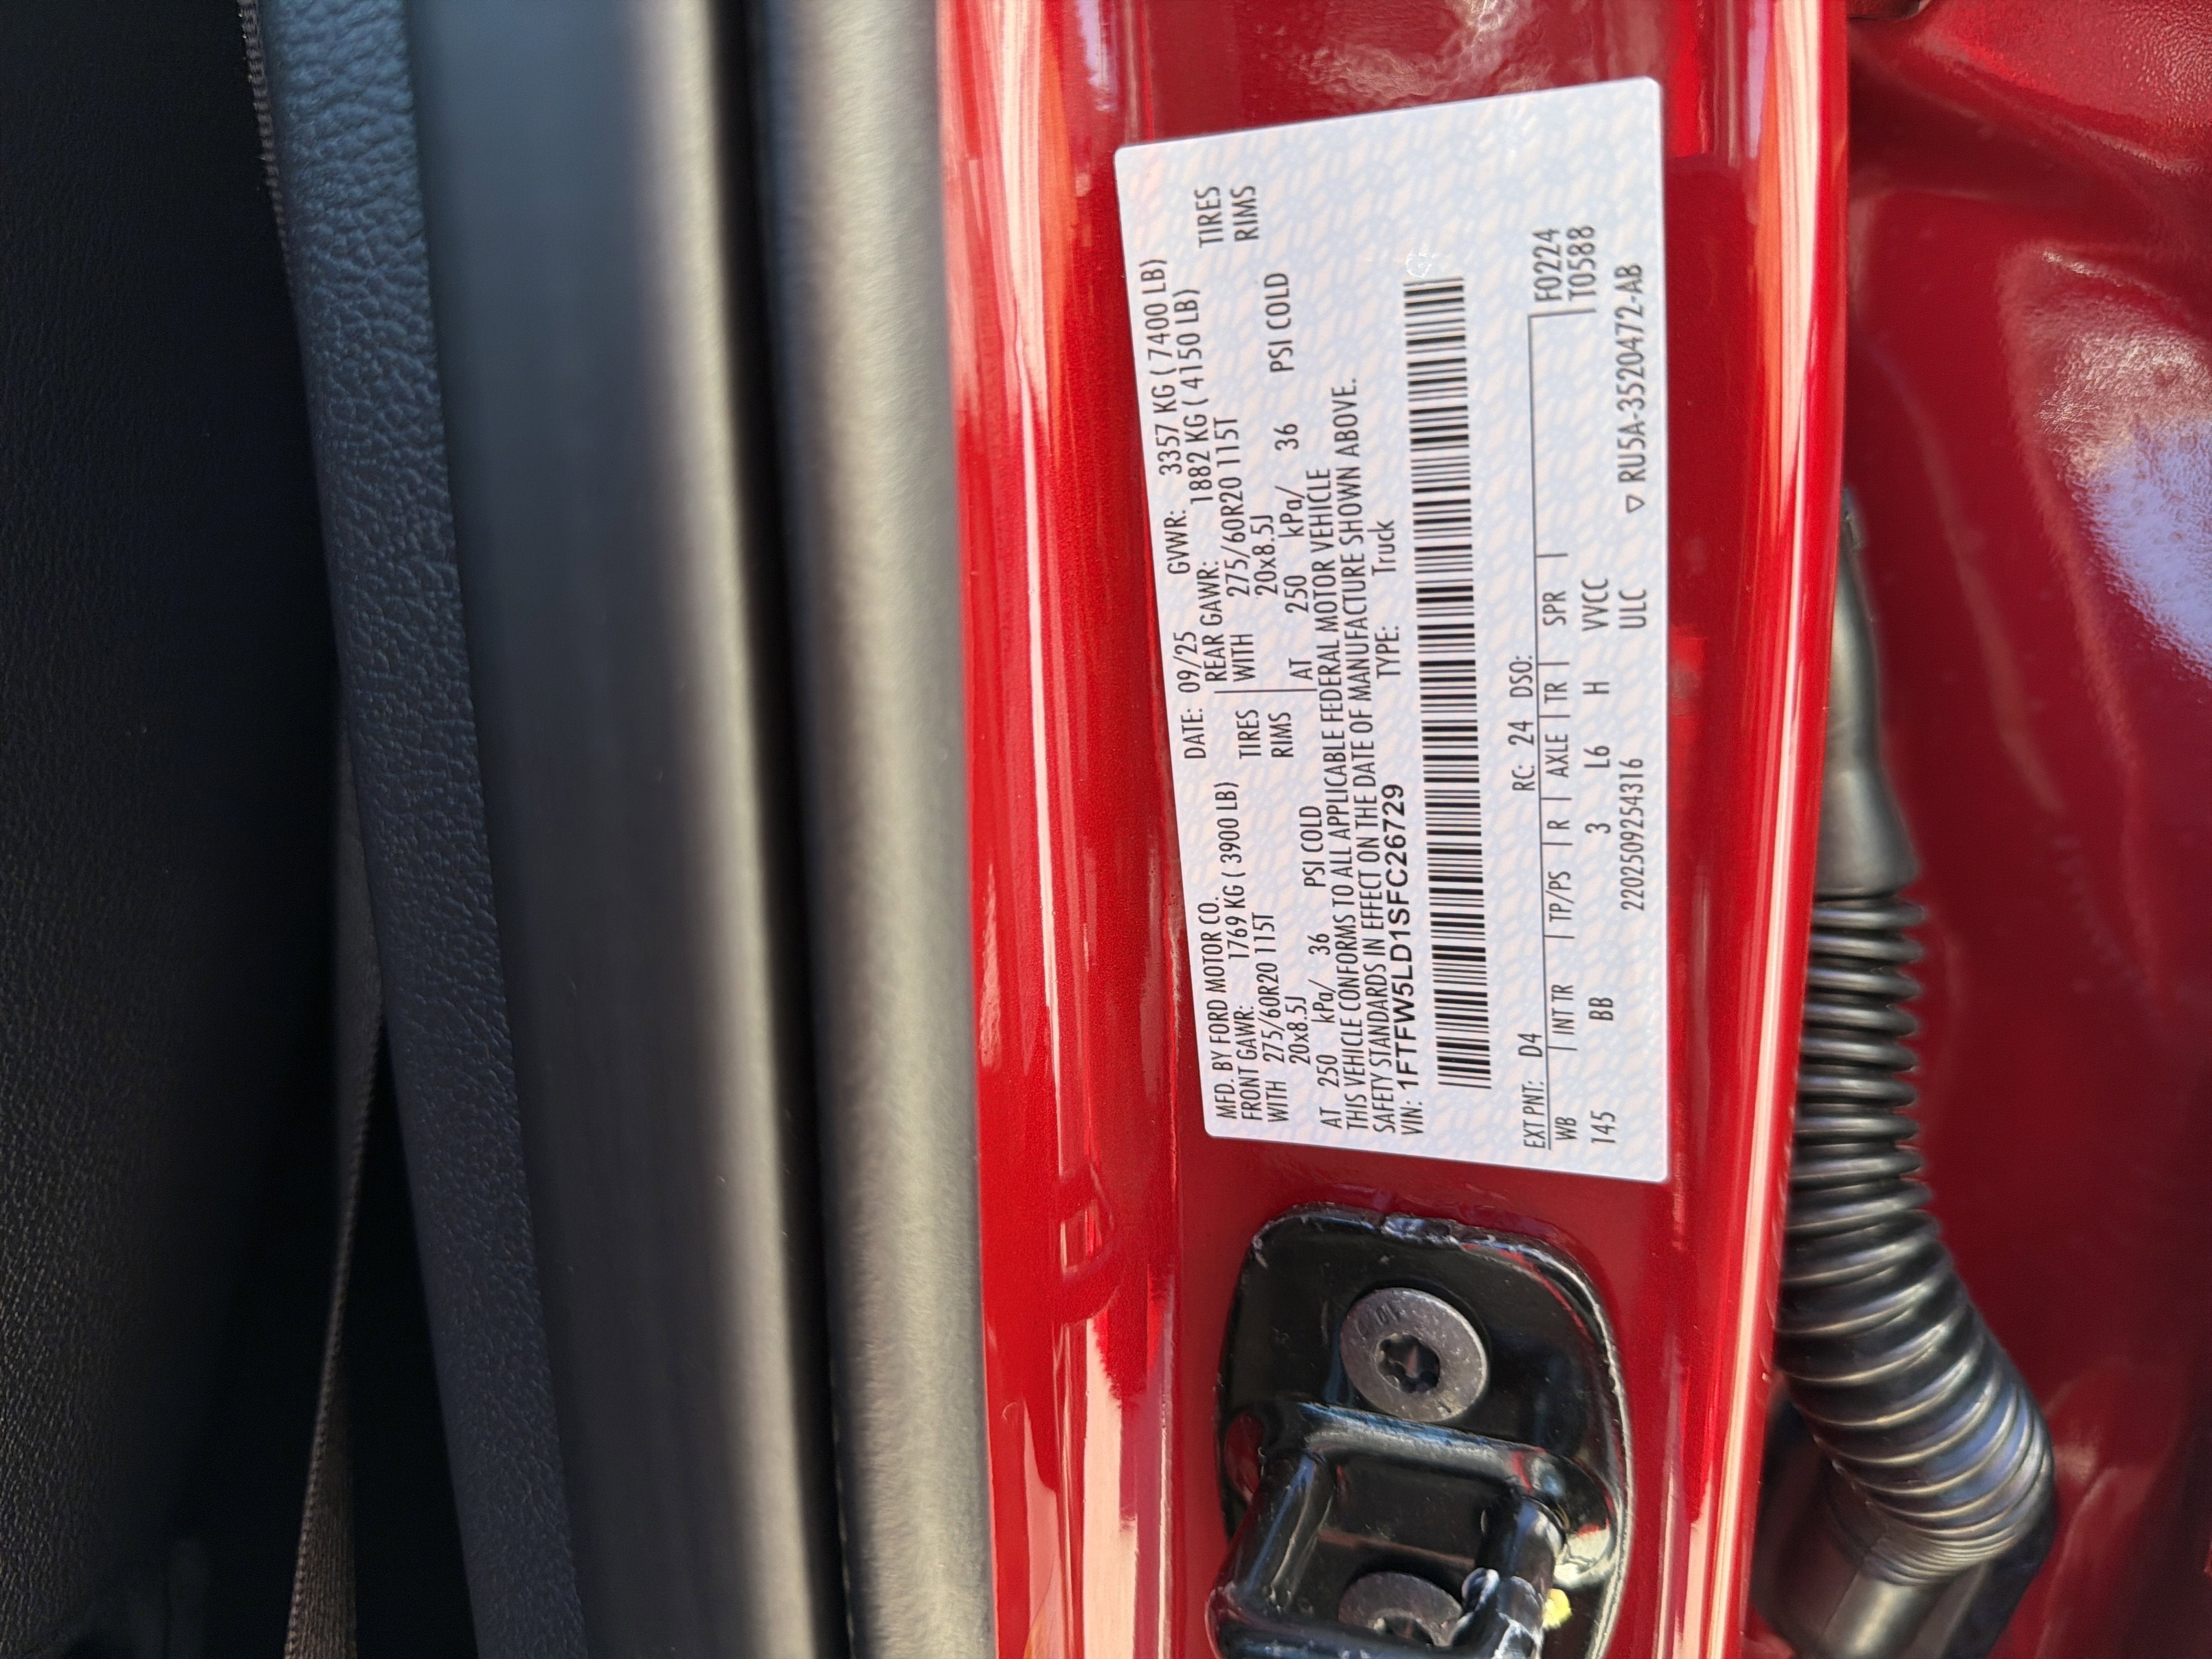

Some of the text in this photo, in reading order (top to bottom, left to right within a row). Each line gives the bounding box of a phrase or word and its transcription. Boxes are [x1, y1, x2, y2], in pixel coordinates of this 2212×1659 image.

[1193, 185, 1225, 249] TIRES
[1229, 185, 1260, 243] RIMS
[1138, 258, 1168, 296] LB)
[1142, 302, 1173, 362] 7400
[1171, 288, 1201, 325] LB)
[1175, 331, 1205, 391] 4150
[1613, 263, 1647, 484] RU5A-3520472-AB
[1150, 383, 1178, 415] KG
[1154, 422, 1183, 477] 3357
[1182, 413, 1210, 444] KG
[1184, 450, 1215, 506] 1882
[1262, 272, 1314, 682] AT 250 kPa/ 36 PSI COLD
[1162, 509, 1192, 575] GVWR:
[1212, 416, 1257, 684] WITH 275/60R20 115T
[1248, 514, 1279, 597] 20x8.5J
[1195, 560, 1224, 627] GAWR:
[1365, 519, 1402, 680] TYPE: Truck
[1541, 590, 1567, 627] SPR
[1580, 578, 1610, 633] VVCC
[1617, 588, 1648, 630] ULC
[1200, 633, 1228, 683] REAR
[1171, 630, 1207, 760] DATE: 09/25
[1543, 681, 1568, 705] TR
[1582, 681, 1611, 696] H
[1234, 708, 1263, 760] TIRES
[1266, 711, 1295, 759] RIMS
[1506, 654, 1536, 792] RC: 24 DSO:
[1330, 377, 1397, 1134] SAFETY STANDARDS IN EFFECT ON THE DATE OF MANUFACTURE SHOWN ABOVE.
[1544, 733, 1570, 779] AXLE
[1582, 744, 1611, 769] L6
[1212, 781, 1240, 811] LB)
[1305, 467, 1370, 1131] THIS VEHICLE CONFORMS TO ALL APPLICABLE FEDERAL MOTOR VEHICLE
[1215, 817, 1243, 865] 3900
[1545, 819, 1571, 831] R
[1583, 822, 1612, 835] 3
[1617, 758, 1646, 912] 2202509254316
[1221, 884, 1247, 910] KG
[1544, 870, 1575, 923] TP/PS
[1223, 915, 1251, 961] 1769
[1379, 783, 1425, 1136] VIN: 1FTFW5LD1SFC26729
[1297, 805, 1343, 1130] AT 250 kPa/ 36 PSI COLD
[1196, 896, 1238, 1120] MFD. BY FORD MOTOR CO.
[1232, 1004, 1259, 1062] GAWR:
[1250, 911, 1290, 1124] WITH 275/60R20 115T
[1283, 995, 1312, 1066] 20x8.5J
[1550, 983, 1576, 1036] INT TR
[1587, 996, 1615, 1022] BB
[1236, 1064, 1264, 1122] FRONT
[1516, 1032, 1547, 1150] EXT PNT: D4
[1554, 1115, 1578, 1141] WB
[1589, 1109, 1617, 1144] 145
